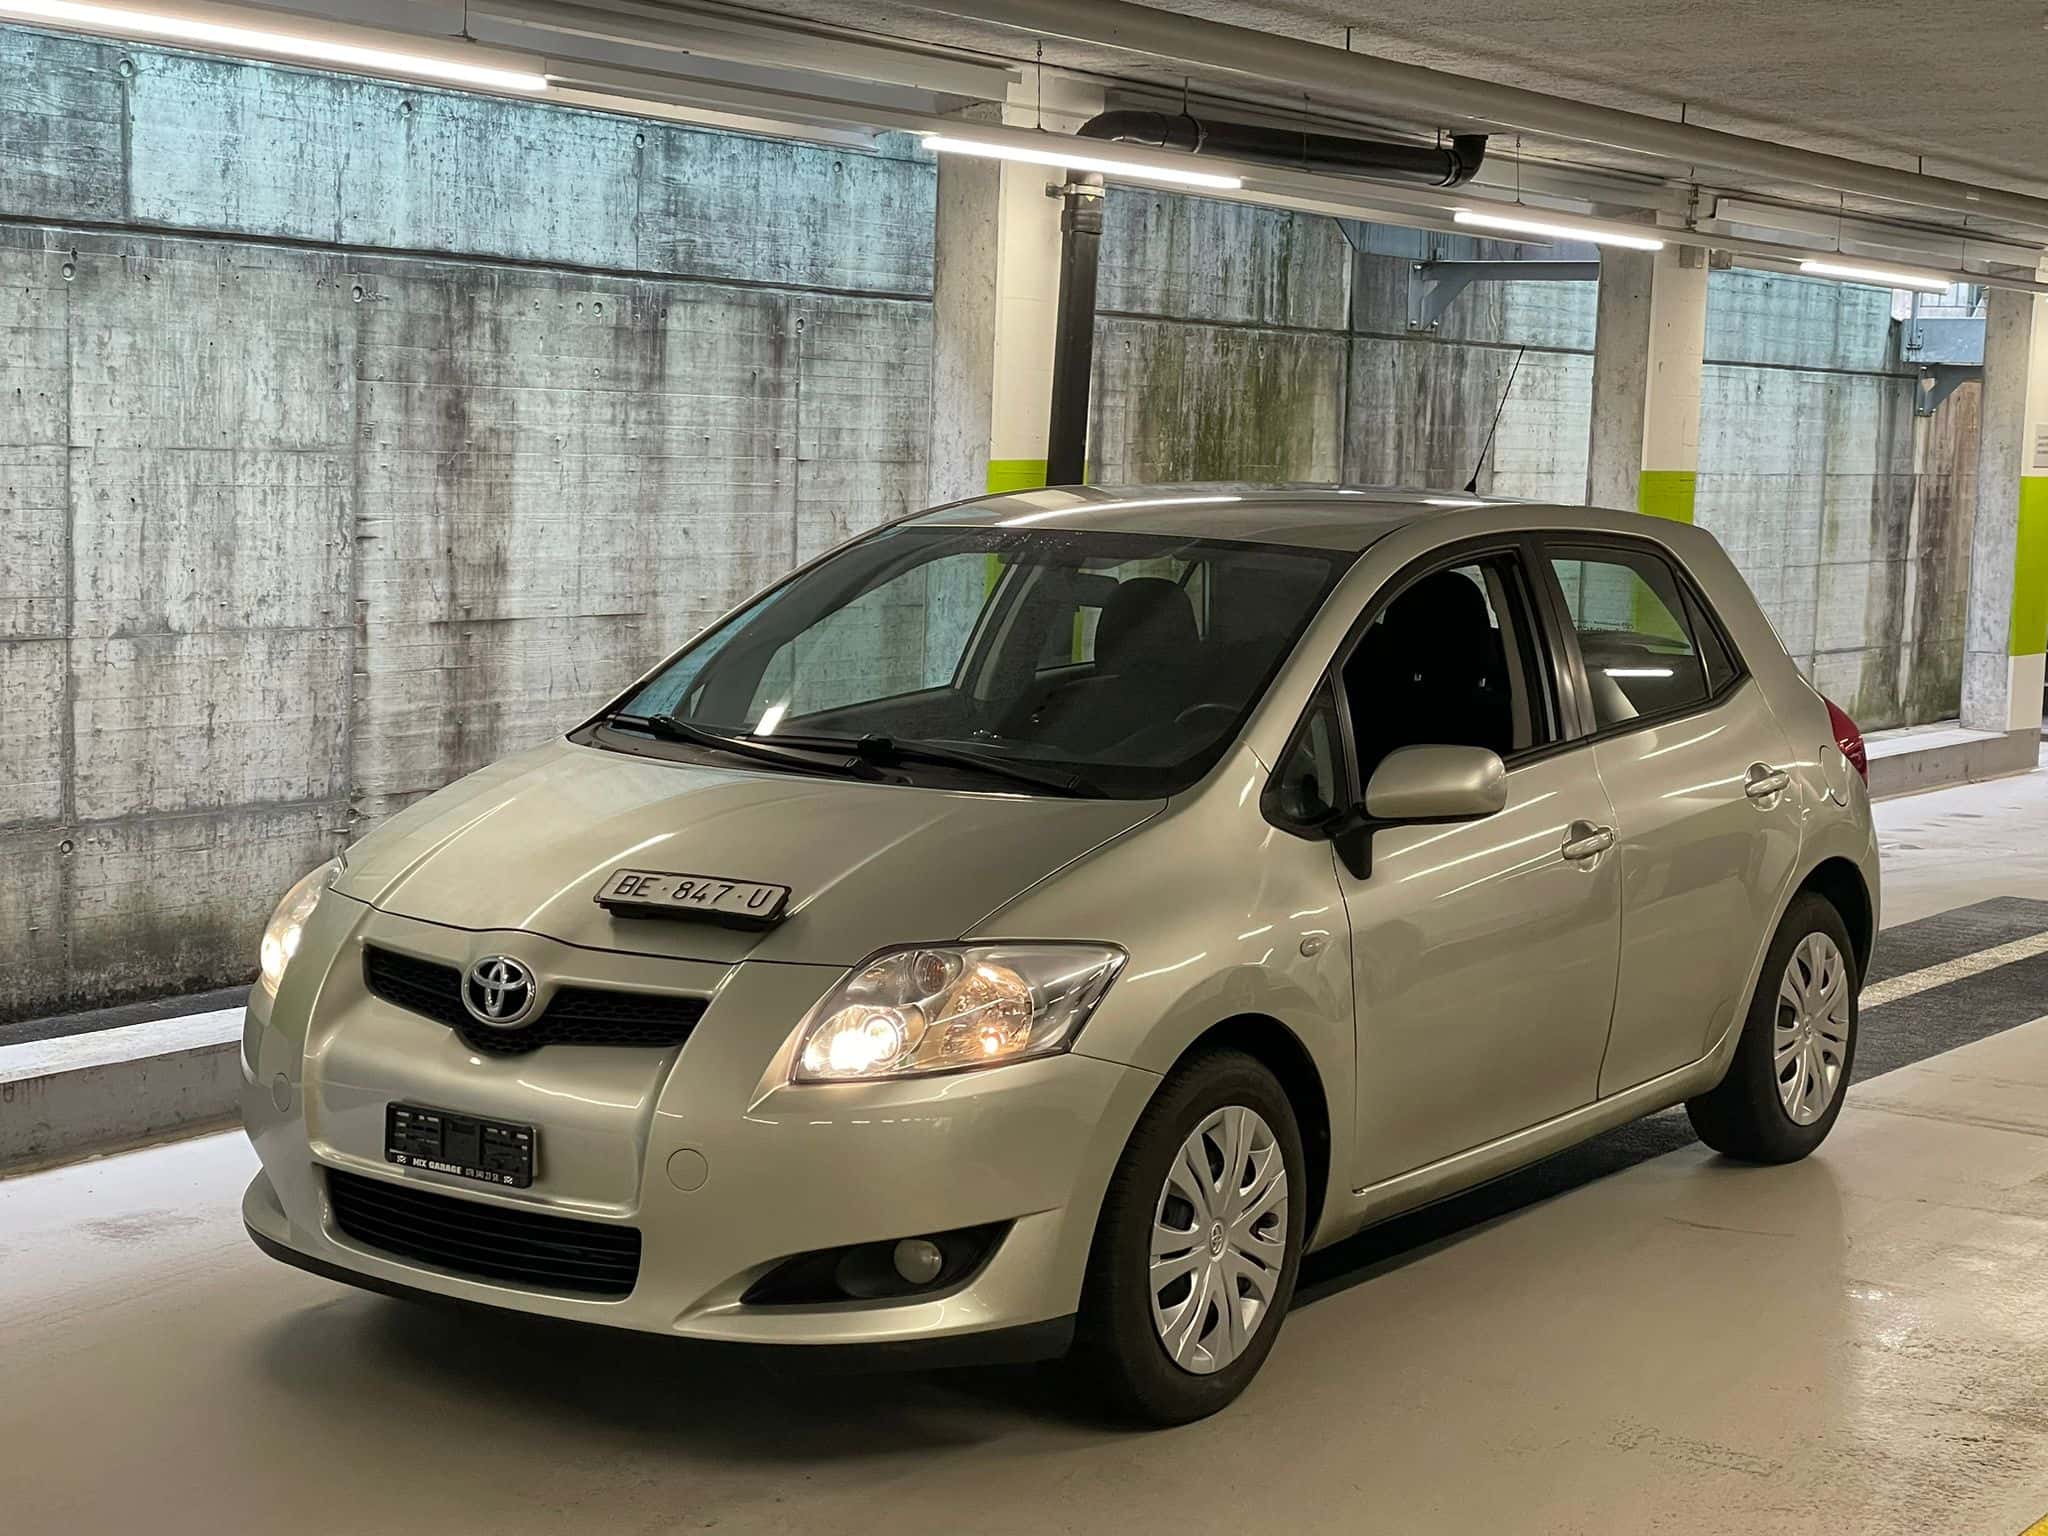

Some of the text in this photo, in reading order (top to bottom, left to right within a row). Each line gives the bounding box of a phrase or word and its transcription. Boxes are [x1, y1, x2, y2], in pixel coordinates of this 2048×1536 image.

[613, 875, 773, 909] BE 847 U
[428, 1160, 462, 1175] GARAGE
